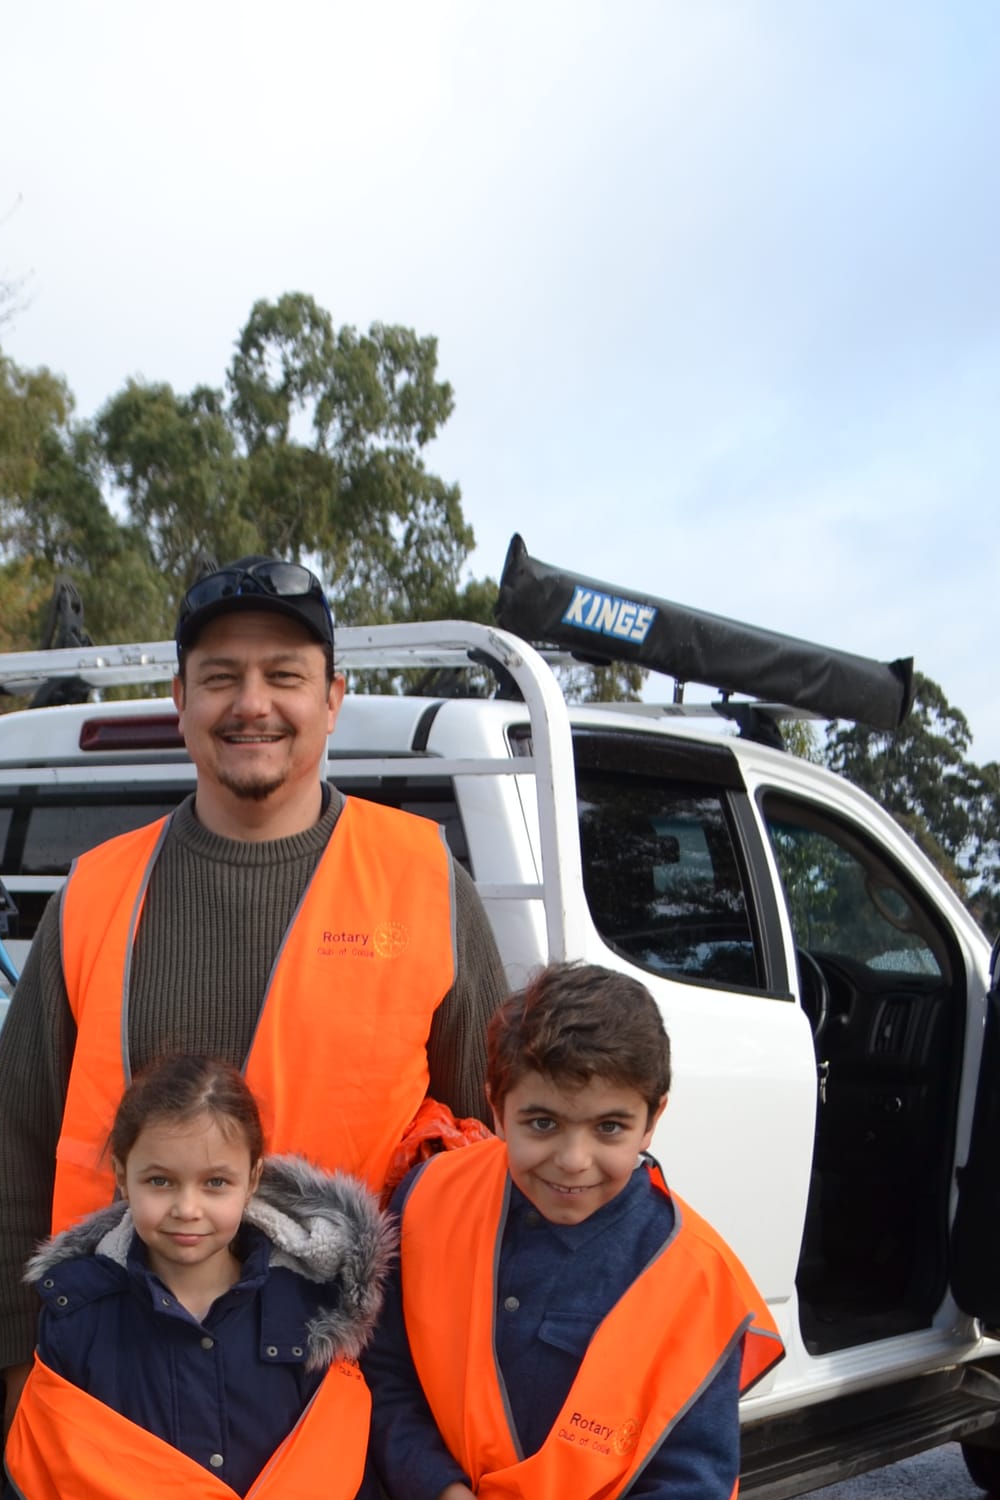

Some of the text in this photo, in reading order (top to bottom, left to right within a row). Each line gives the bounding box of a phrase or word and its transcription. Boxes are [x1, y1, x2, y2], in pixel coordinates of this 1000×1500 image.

[566, 590, 656, 640] KINGS
[323, 931, 369, 945] Rotary
[569, 1412, 614, 1440] Rotary
